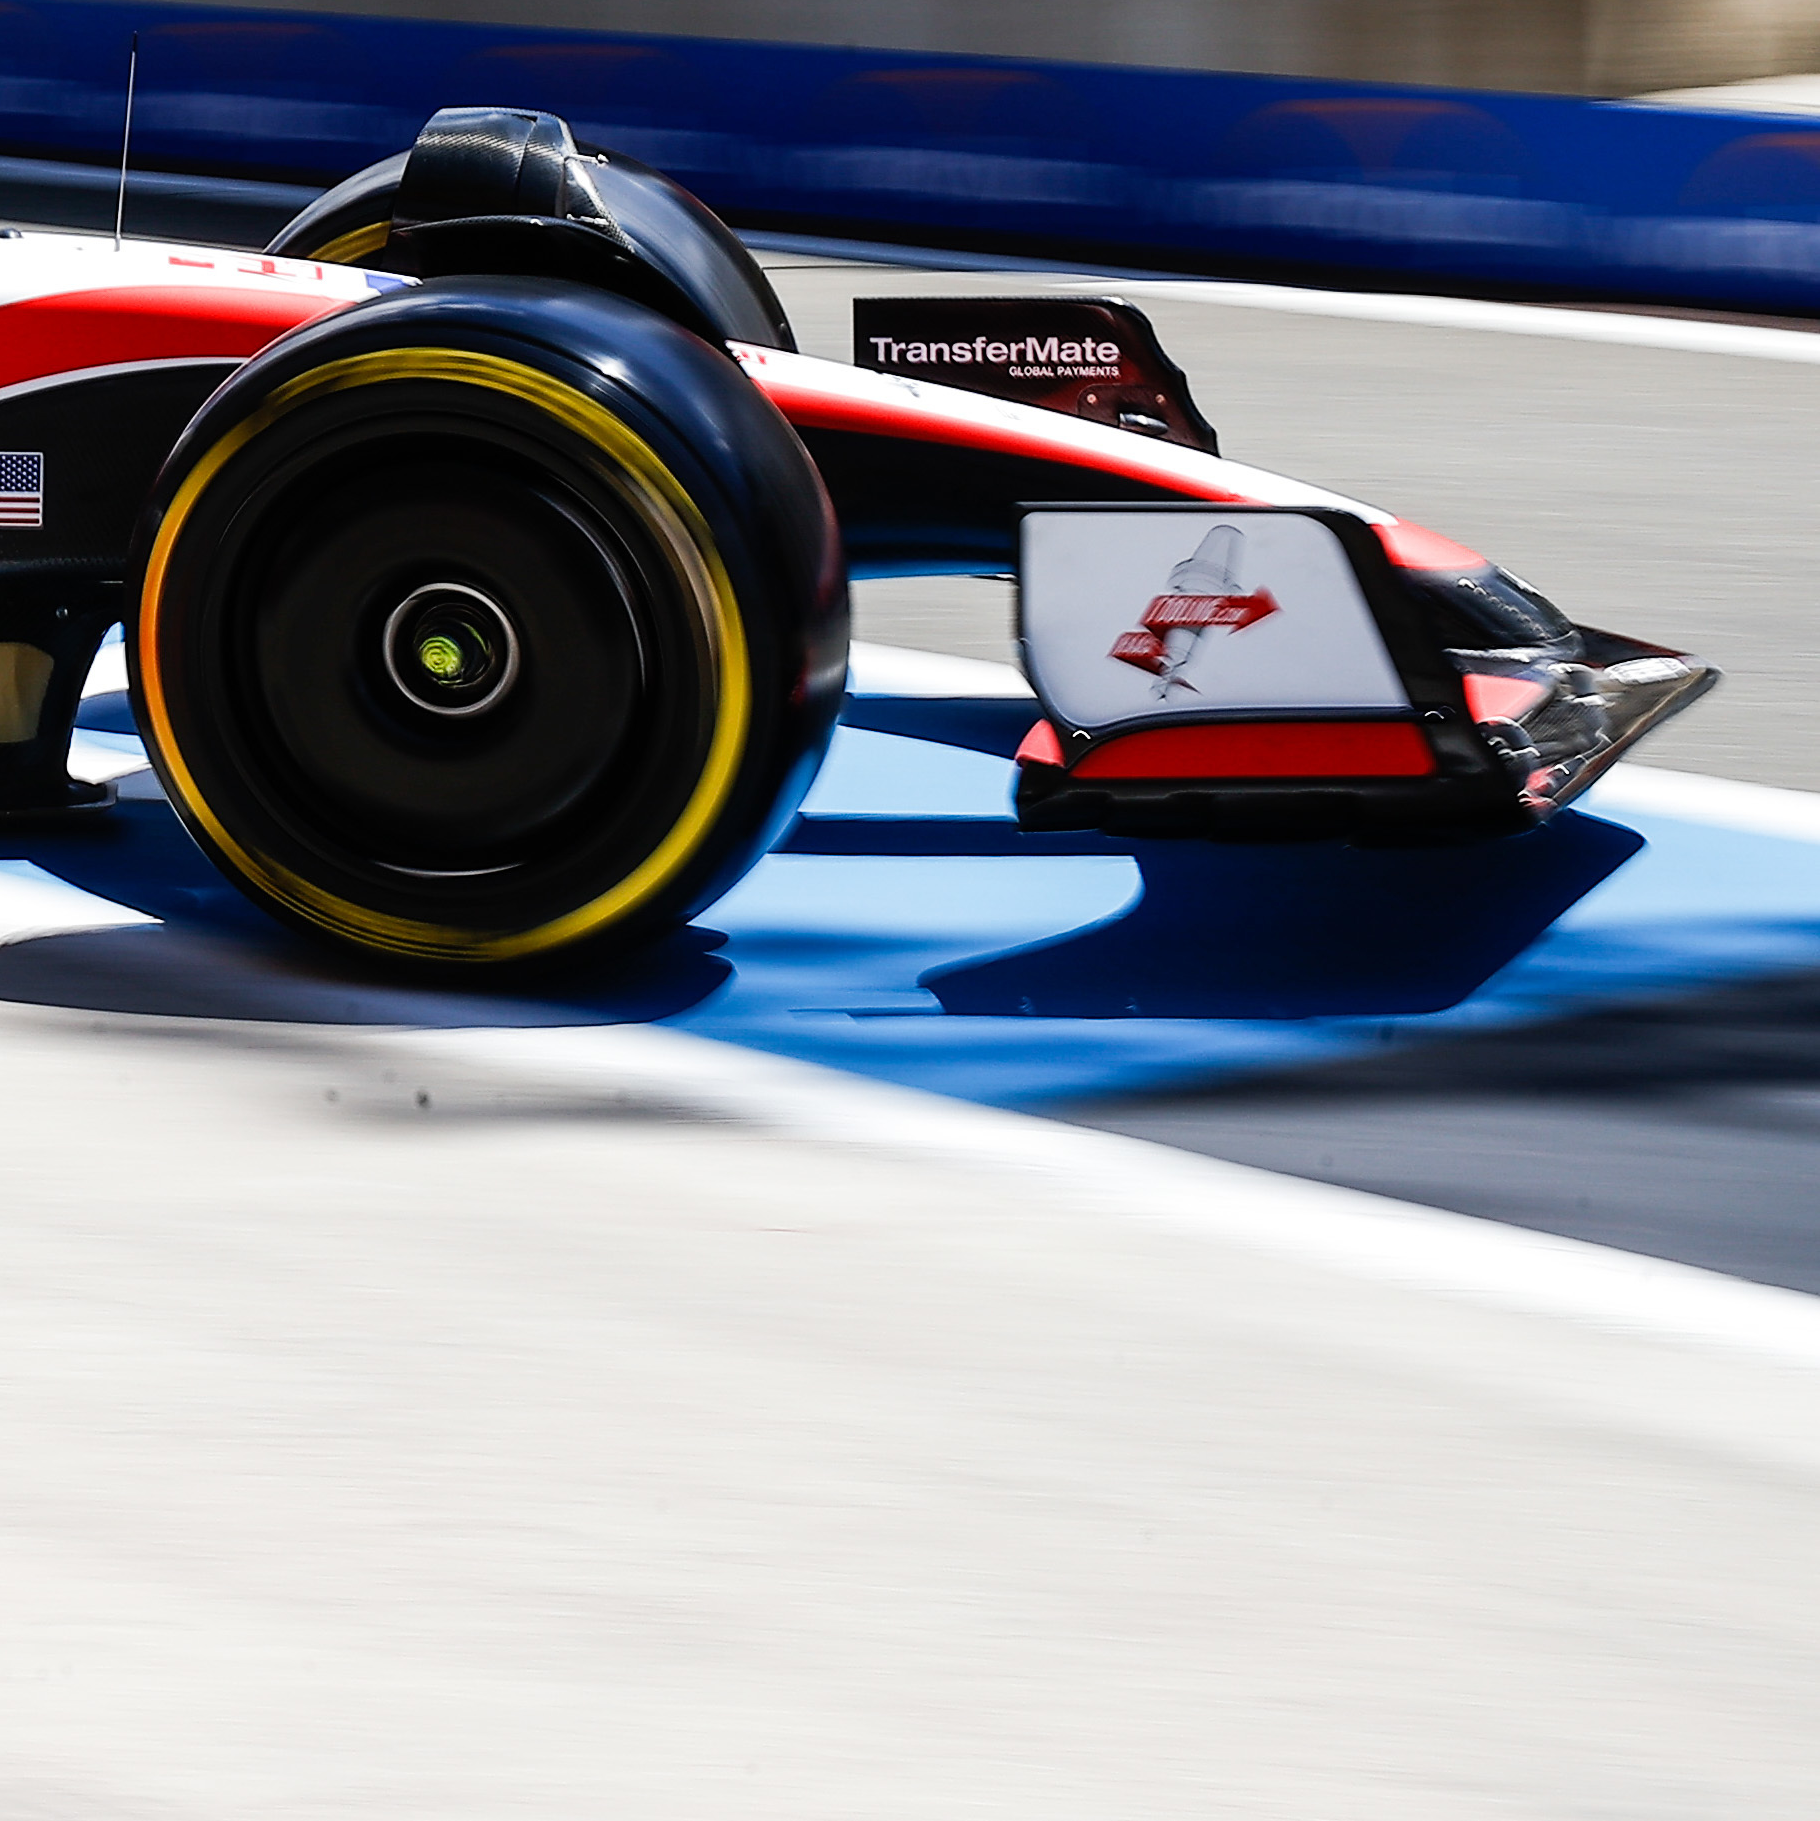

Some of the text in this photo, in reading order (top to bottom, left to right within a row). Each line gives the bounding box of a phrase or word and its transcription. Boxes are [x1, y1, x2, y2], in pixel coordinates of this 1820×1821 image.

[869, 336, 1121, 364] TransferMate
[1009, 366, 1120, 377] GLOBAL PAYMENTS
